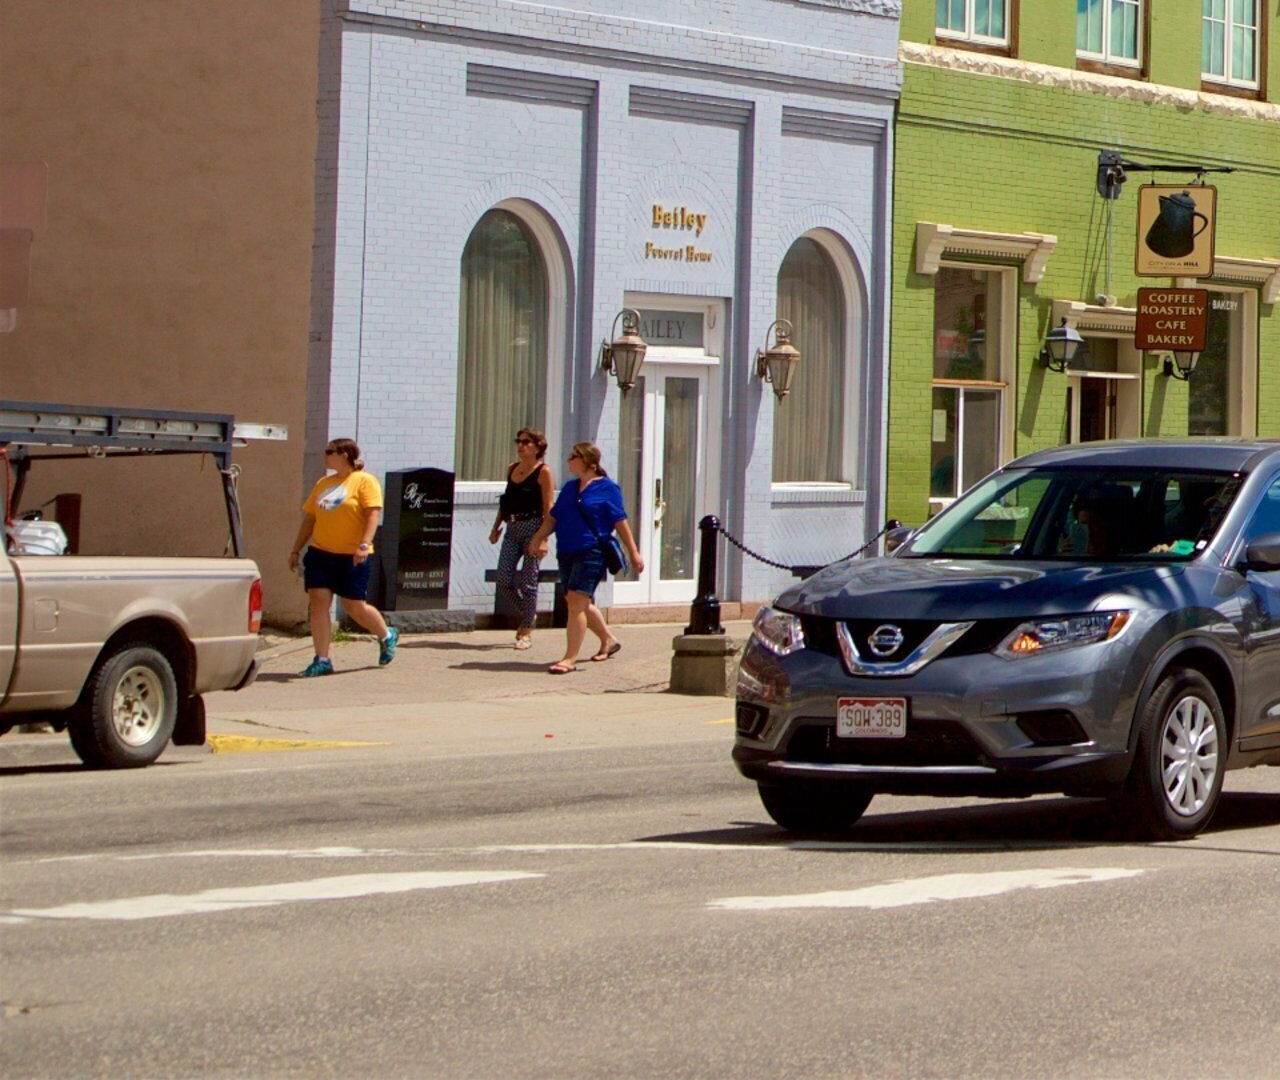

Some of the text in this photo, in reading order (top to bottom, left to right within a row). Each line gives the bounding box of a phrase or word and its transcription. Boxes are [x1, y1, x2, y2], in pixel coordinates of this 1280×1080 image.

[652, 204, 707, 238] Bailey
[645, 242, 713, 264] Funeral Home
[1148, 293, 1196, 304] COFFEE
[1140, 305, 1204, 316] ROASTERY
[1212, 300, 1238, 311] BAKERY
[638, 319, 686, 339] AILEY
[1155, 320, 1187, 330] CAFE
[1147, 334, 1195, 345] BAKERY
